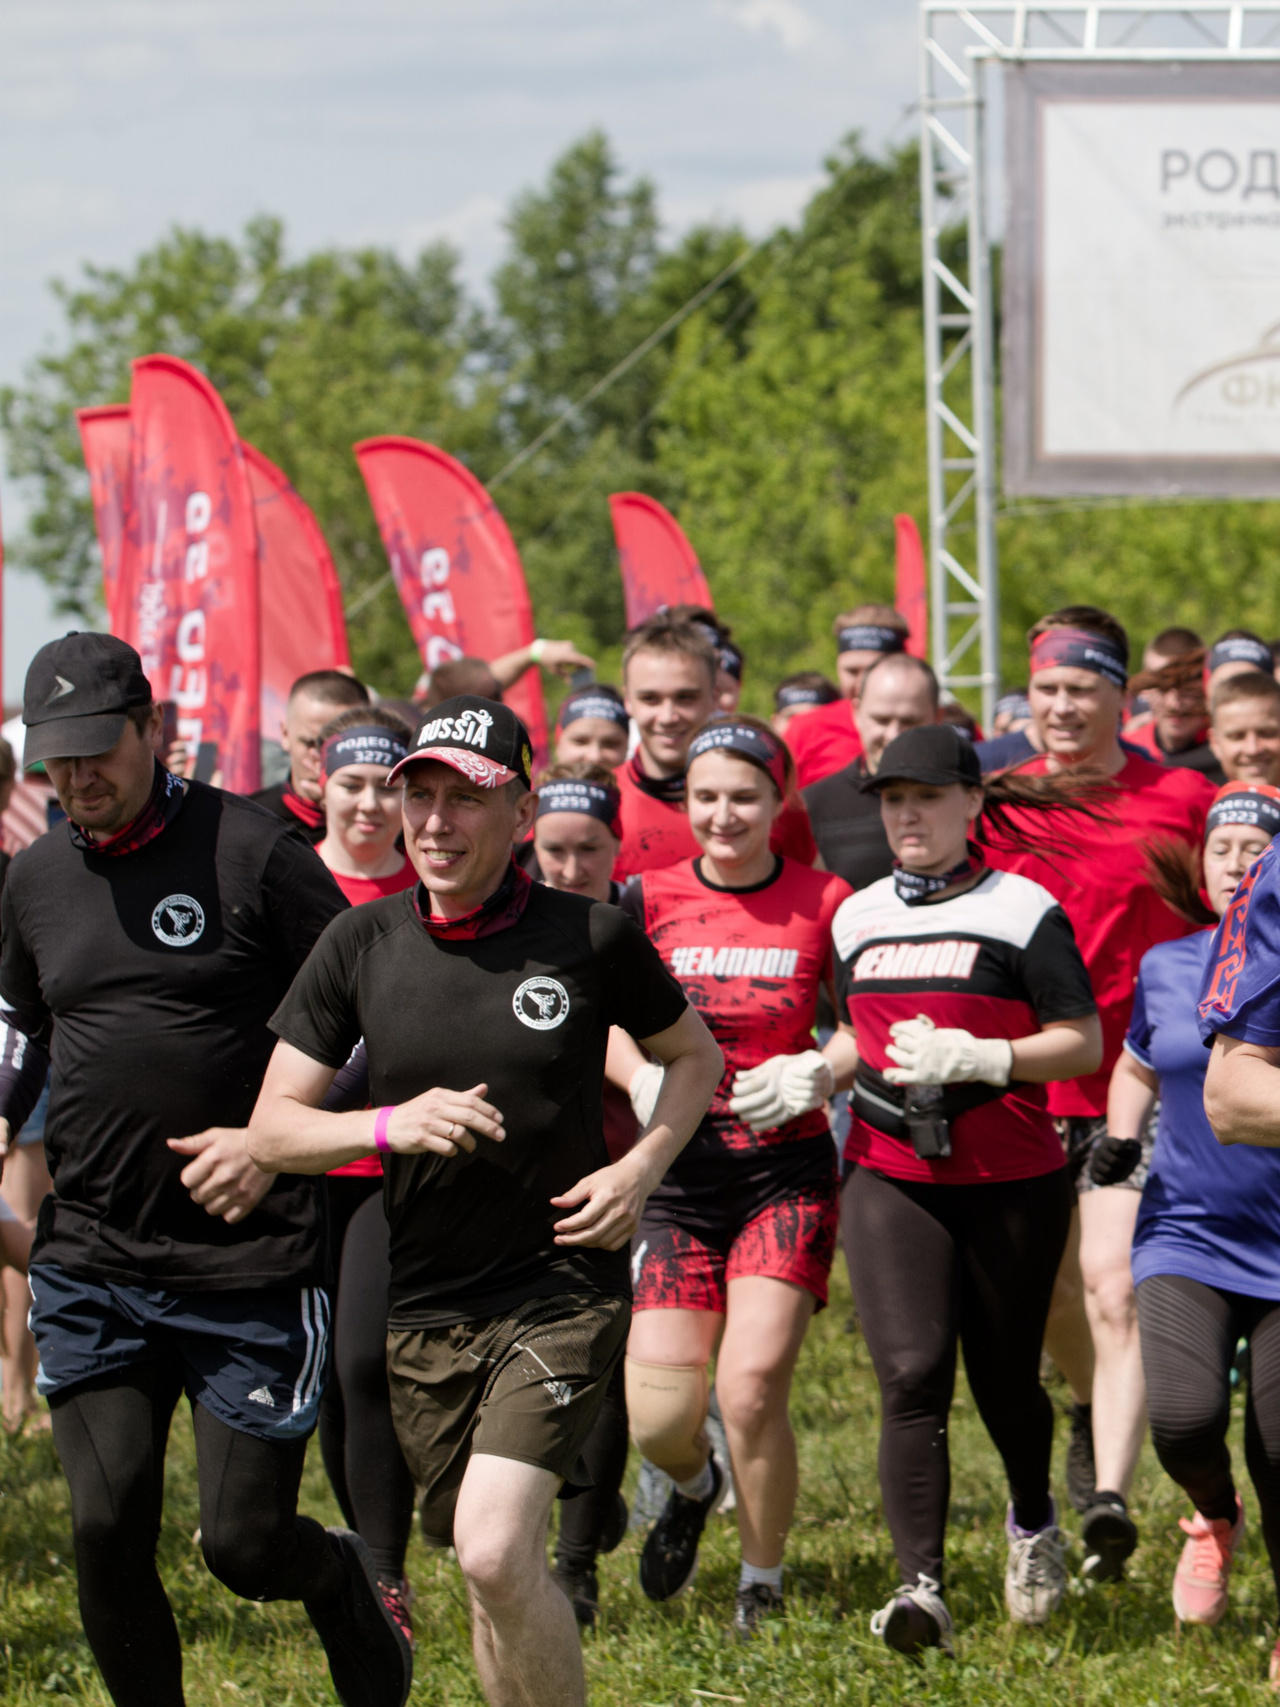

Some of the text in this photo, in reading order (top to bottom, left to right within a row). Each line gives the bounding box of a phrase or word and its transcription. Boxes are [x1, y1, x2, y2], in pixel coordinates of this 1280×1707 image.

[335, 736, 391, 753] РОДЕО
[417, 709, 494, 749] RUSSIA
[354, 750, 392, 765] 3277
[671, 946, 798, 977] ЧЕМПИОН
[852, 941, 981, 982] ЧЕМПИОН
